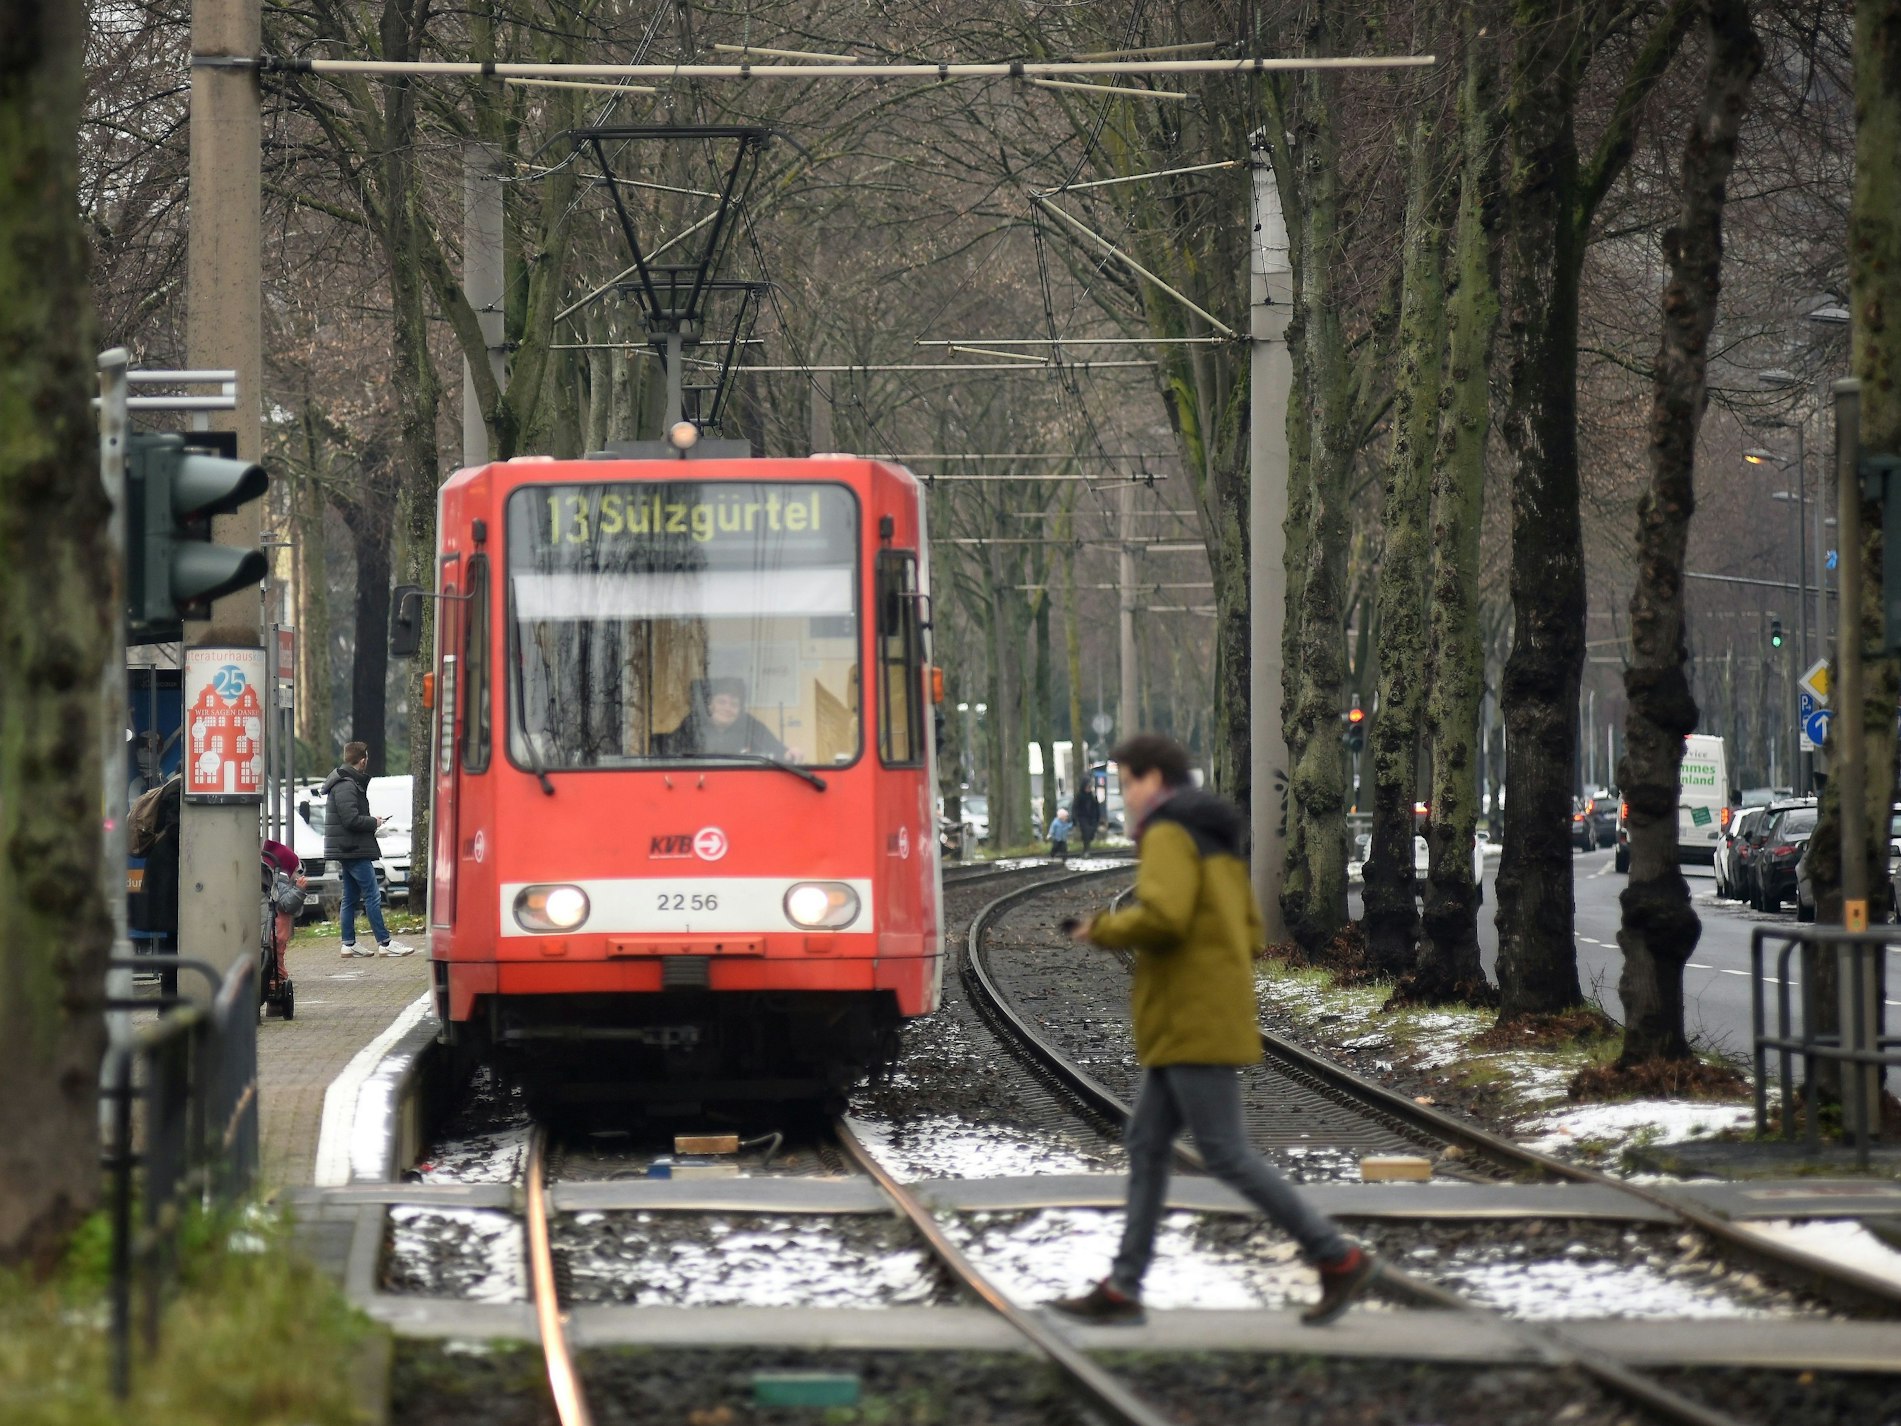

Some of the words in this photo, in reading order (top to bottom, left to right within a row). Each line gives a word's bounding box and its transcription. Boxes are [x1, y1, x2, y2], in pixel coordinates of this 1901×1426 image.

[547, 494, 590, 545] 13
[601, 490, 821, 542] Sülzgürtel
[215, 669, 246, 696] 25
[195, 708, 210, 716] WIR
[211, 708, 236, 716] SAGEN
[649, 834, 694, 856] KVB
[657, 893, 718, 911] 2256
